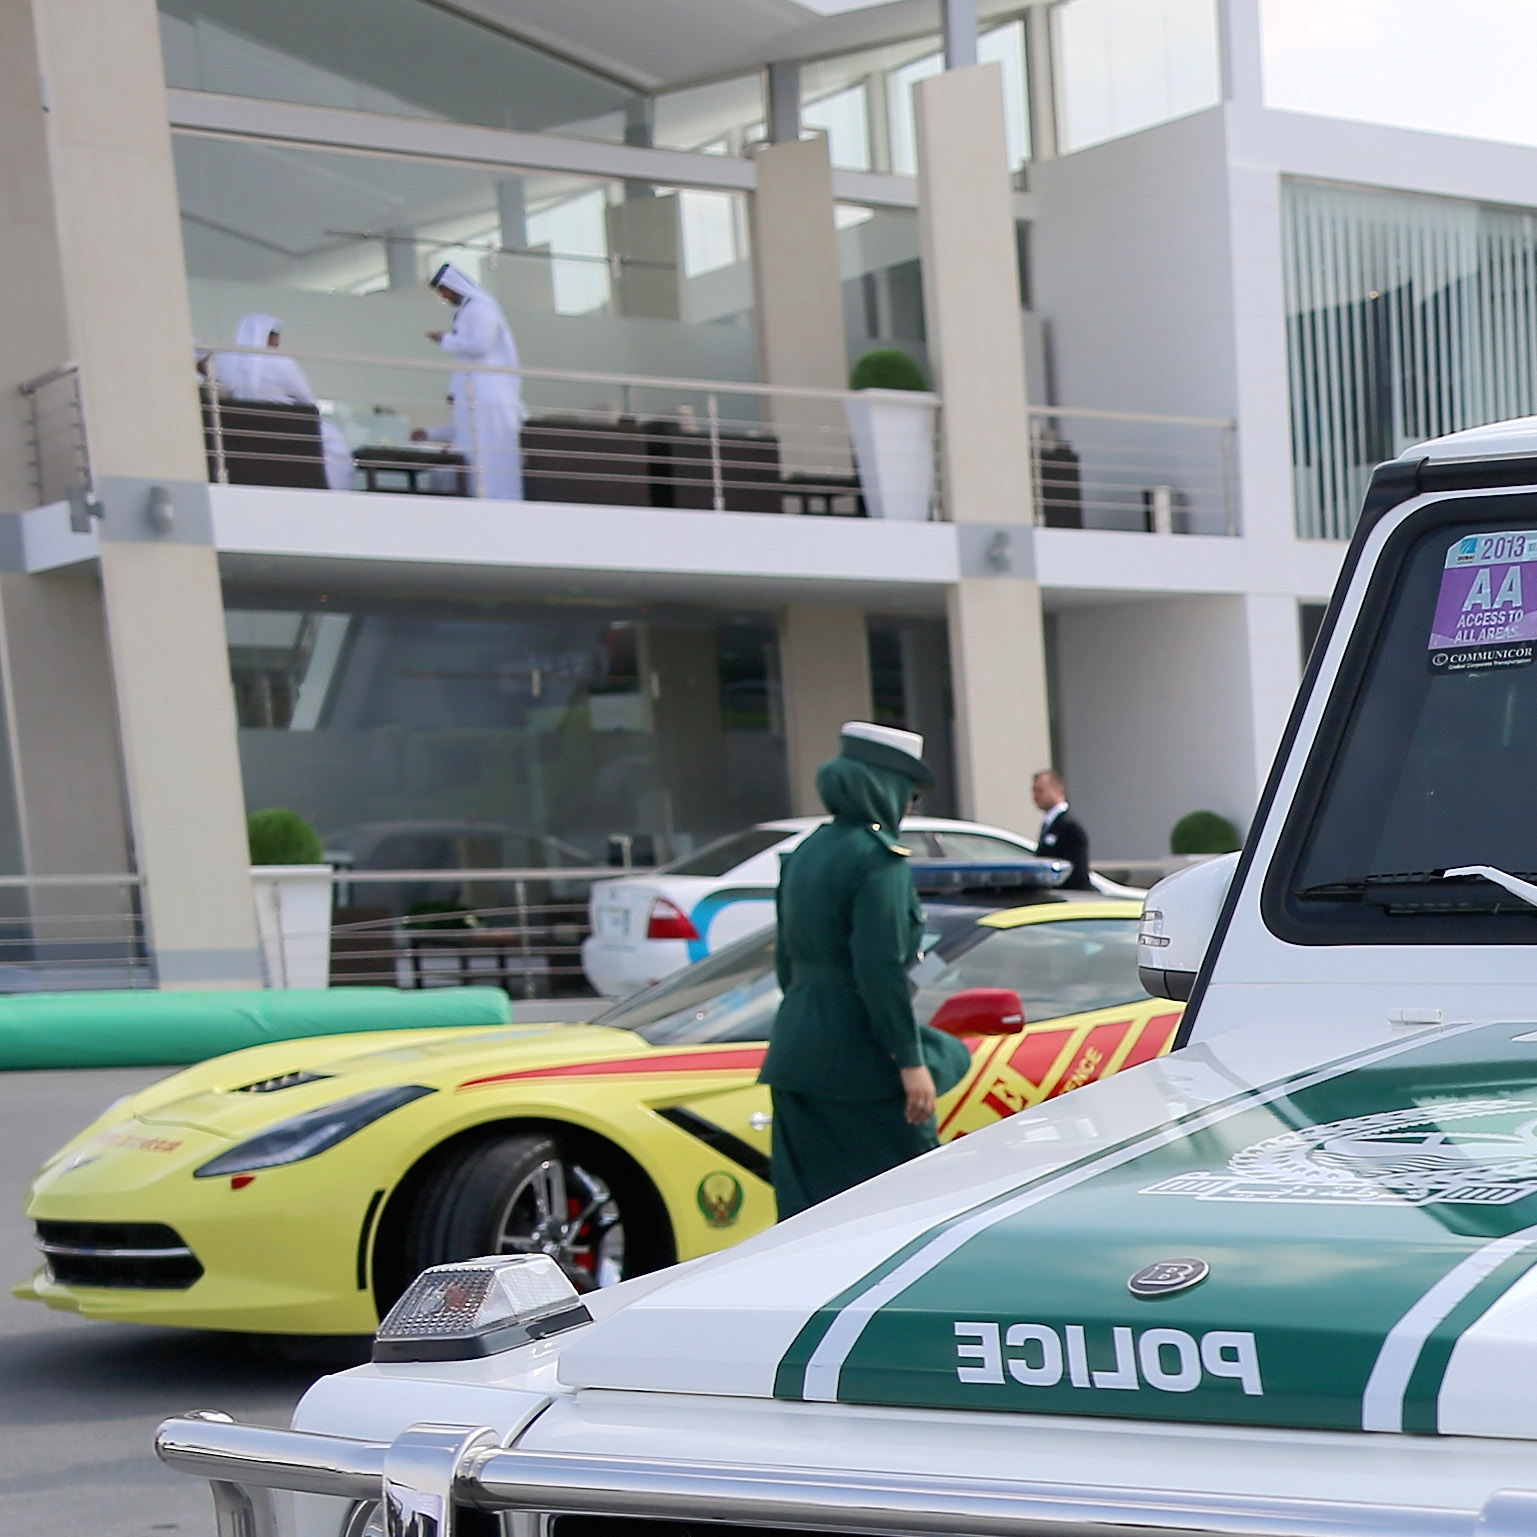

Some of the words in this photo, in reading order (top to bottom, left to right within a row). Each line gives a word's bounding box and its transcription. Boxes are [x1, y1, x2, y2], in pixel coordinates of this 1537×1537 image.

[1482, 536, 1526, 560] 2013
[1462, 566, 1522, 611] AA
[1457, 613, 1506, 628] ACCESS
[1508, 610, 1524, 623] TO
[1455, 630, 1475, 644] ALL
[1478, 626, 1519, 641] AREAS
[1450, 648, 1532, 663] COMMUNICOR
